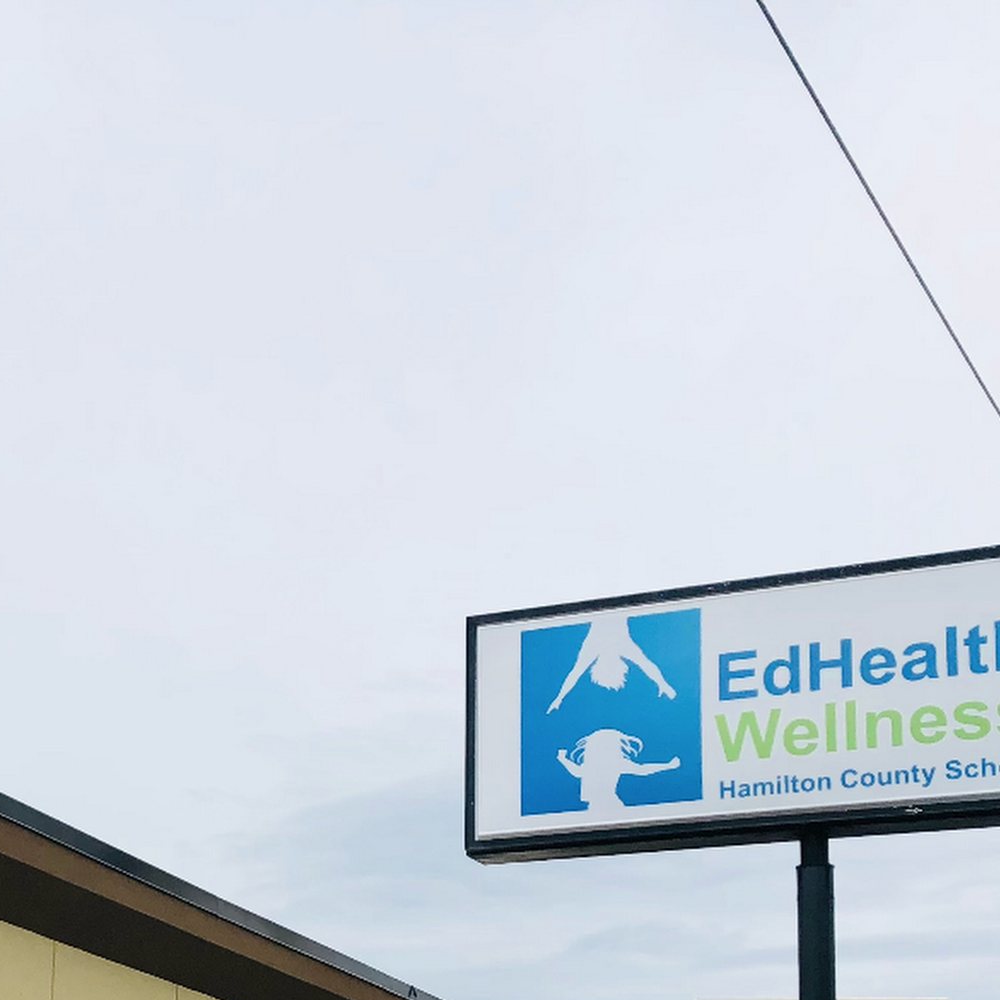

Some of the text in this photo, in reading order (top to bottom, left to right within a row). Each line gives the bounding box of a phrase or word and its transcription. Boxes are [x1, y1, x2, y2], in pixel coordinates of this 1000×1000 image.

[718, 620, 1000, 701] EdHealt
[715, 700, 1000, 762] Wellnes
[719, 757, 1000, 799] Hamilton County Sch
